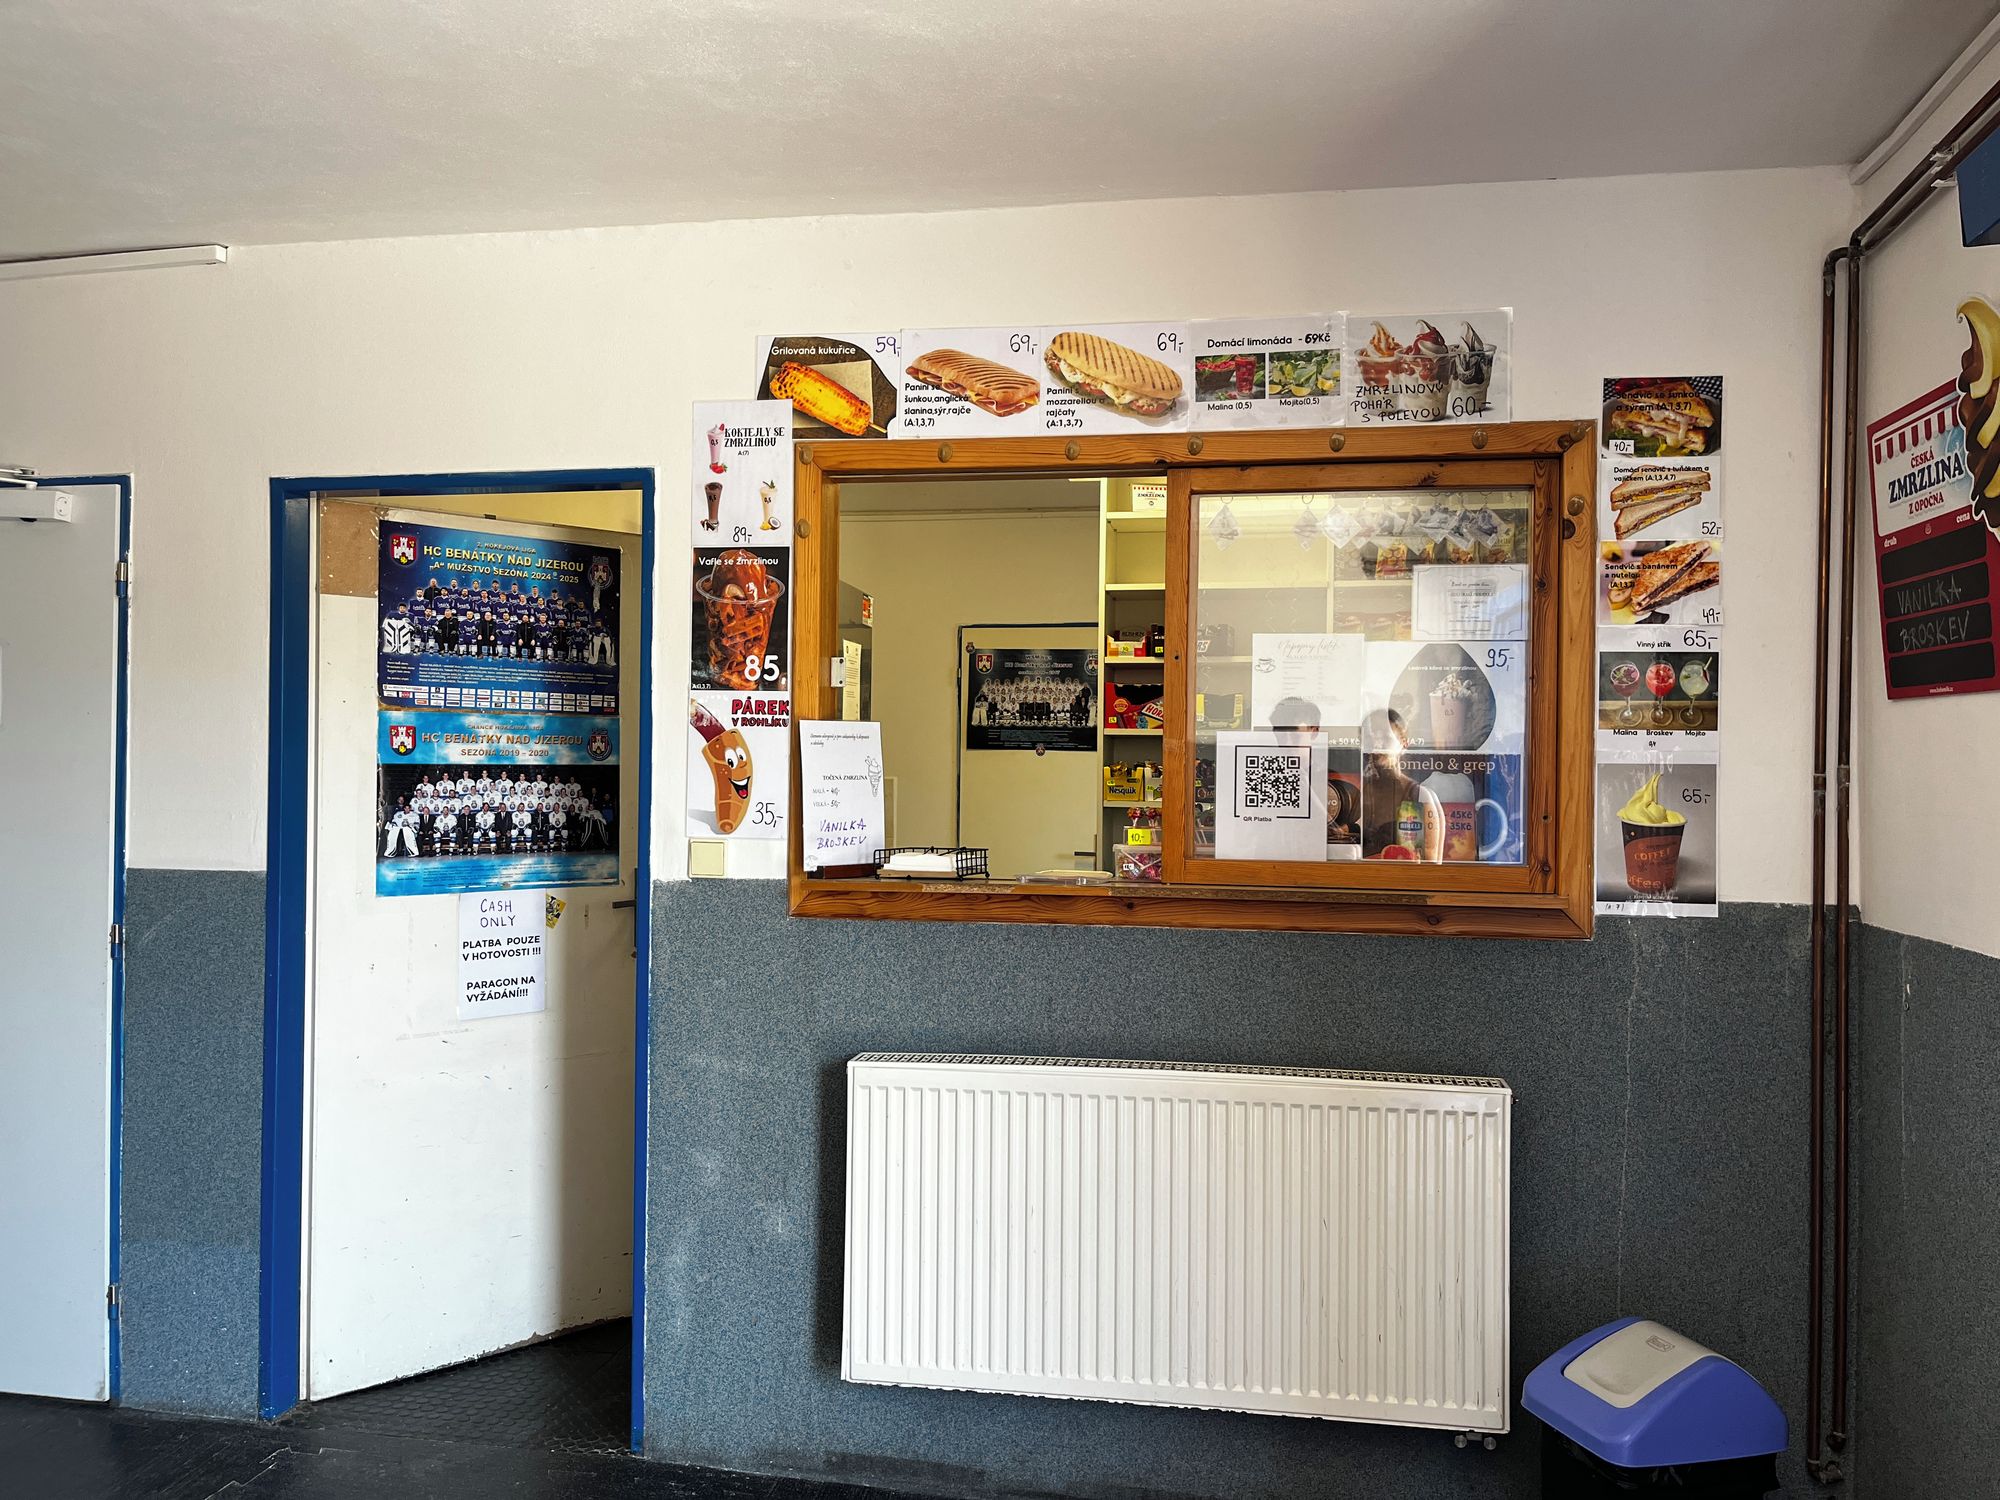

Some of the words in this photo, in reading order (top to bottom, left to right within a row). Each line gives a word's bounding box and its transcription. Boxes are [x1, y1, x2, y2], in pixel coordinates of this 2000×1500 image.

[875, 336, 901, 357] 59,-
[1009, 334, 1038, 355] 69,-
[1157, 332, 1184, 353] 69,-
[1207, 338, 1245, 348] Domácí
[1247, 336, 1292, 346] limonáda
[771, 346, 816, 355] Grilovaná
[818, 345, 856, 355] kukuřice
[904, 383, 929, 391] Panini
[1046, 387, 1073, 395] Panini
[1355, 381, 1444, 398] ZMRZLINOVÝ
[904, 395, 969, 404] šunkou,anglická
[1046, 397, 1096, 406] mozzarellou
[1350, 396, 1394, 412] POHÁR
[904, 405, 971, 416] slanina,sýr,rajče
[1046, 408, 1076, 417] rajčaty
[1207, 403, 1233, 411] Malina
[1235, 402, 1252, 410] (0,5)
[1452, 396, 1492, 418] 60,-
[1624, 403, 1654, 412] sýrem
[1378, 407, 1441, 422] POLEVOU
[1046, 419, 1083, 429] (A:1,3,7)
[724, 427, 773, 438] KOKTEJLY
[774, 427, 785, 437] SE
[724, 437, 777, 448] ZMRZLINOU
[1911, 446, 1935, 468] ČESKÁ
[1614, 475, 1644, 483] vajíčkem
[1888, 452, 1964, 503] ZMRZLINA
[1909, 504, 1914, 514] Z
[1915, 491, 1944, 512] OPOČNA
[1956, 512, 1971, 523] cena
[732, 526, 752, 543] 89,-
[1884, 536, 1897, 548] druh
[423, 545, 442, 557] HC
[445, 548, 504, 564] BENÁTKY
[508, 554, 532, 567] NAD
[535, 559, 584, 572] JIZEROU
[698, 557, 722, 566] Vafle
[724, 558, 734, 566] se
[736, 557, 779, 566] zmrzlinou
[447, 563, 491, 574] MUŽSTVO
[493, 566, 529, 578] SEZÓNA
[531, 572, 552, 580] 2024
[560, 575, 579, 584] 2025
[1897, 575, 1962, 615] VANILKA
[1900, 610, 1970, 651] BROSKEV
[1637, 641, 1656, 649] Vinný
[1683, 629, 1718, 650] 65,-
[744, 655, 780, 681] 85
[731, 696, 790, 716] PÁREK
[731, 718, 739, 727] V
[741, 716, 789, 728] ROHLÍKU
[422, 733, 441, 743] HC
[444, 732, 502, 745] BENÁTKY
[506, 734, 531, 744] NAD
[534, 734, 583, 746] JIZEROU
[1646, 729, 1674, 737] Broskev
[1685, 729, 1707, 738] Mojito
[1350, 737, 1361, 745] Kč
[461, 747, 497, 757] SEZÓNA
[500, 749, 521, 757] 2019
[528, 749, 550, 757] 2020
[1448, 758, 1459, 771] &
[1463, 760, 1496, 775] grep
[1108, 786, 1137, 795] Nesquik
[752, 801, 784, 828] 35,-
[1450, 810, 1473, 819] 45Kč
[820, 818, 867, 832] VANILKA
[1450, 822, 1472, 831] 35Kč
[817, 836, 867, 849] BROSKEV
[480, 898, 512, 913] CASH
[480, 915, 516, 928] ONLY
[462, 939, 502, 949] PLATBA
[507, 935, 540, 945] POUZE
[462, 953, 469, 961] V
[472, 948, 530, 961] HOTOVOSTI
[532, 947, 541, 955] !!!
[466, 978, 518, 990] PARAGON
[521, 976, 536, 985] NA
[466, 987, 529, 1002] VYŽÁDÁNÍ!!!
